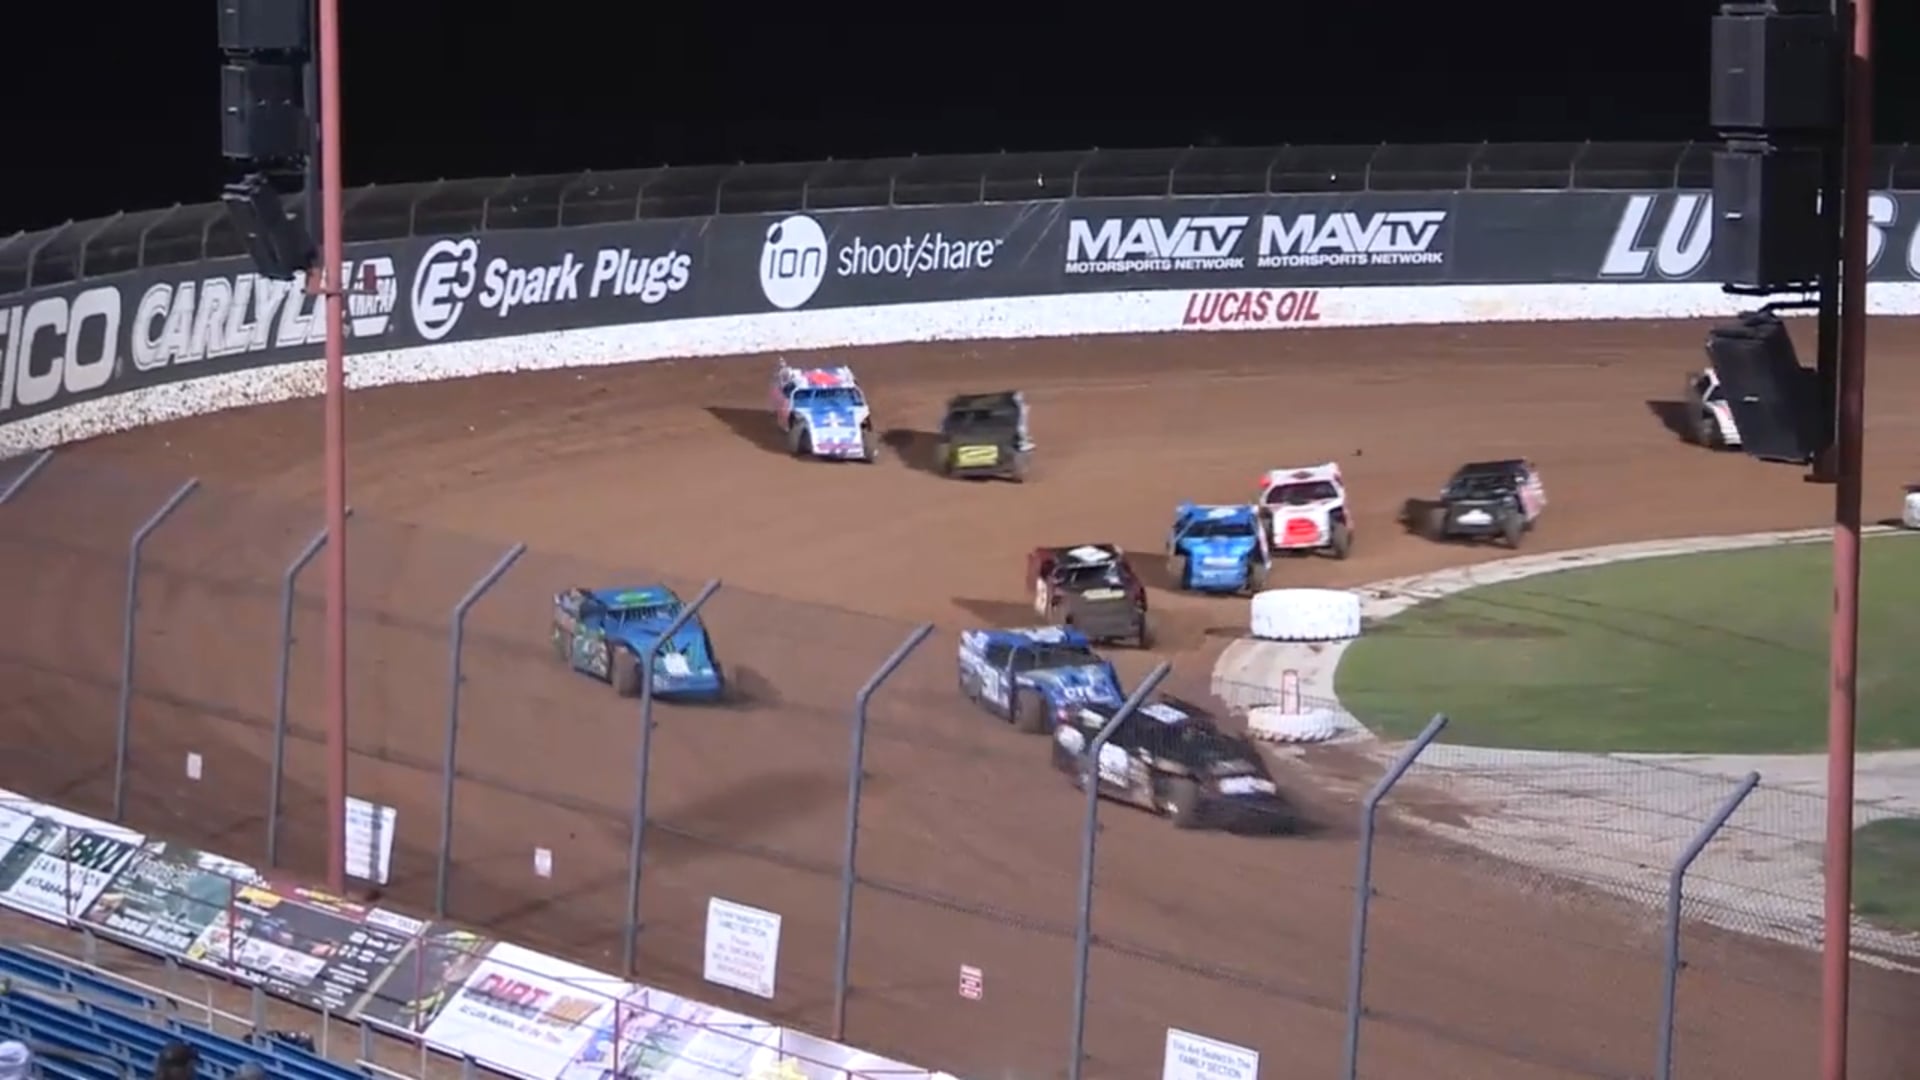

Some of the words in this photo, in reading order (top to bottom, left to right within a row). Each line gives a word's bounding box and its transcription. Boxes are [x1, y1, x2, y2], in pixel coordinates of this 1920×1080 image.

[1065, 259, 1172, 274] MOTORSPORTS
[1174, 257, 1244, 270] NETWORK
[1257, 254, 1368, 268] MOTORSPORTS
[1371, 252, 1443, 265] NETWORK
[479, 253, 583, 317] Spark
[590, 249, 691, 304] Plugs
[1182, 291, 1273, 326] LUCAS
[1276, 290, 1321, 322] OIL
